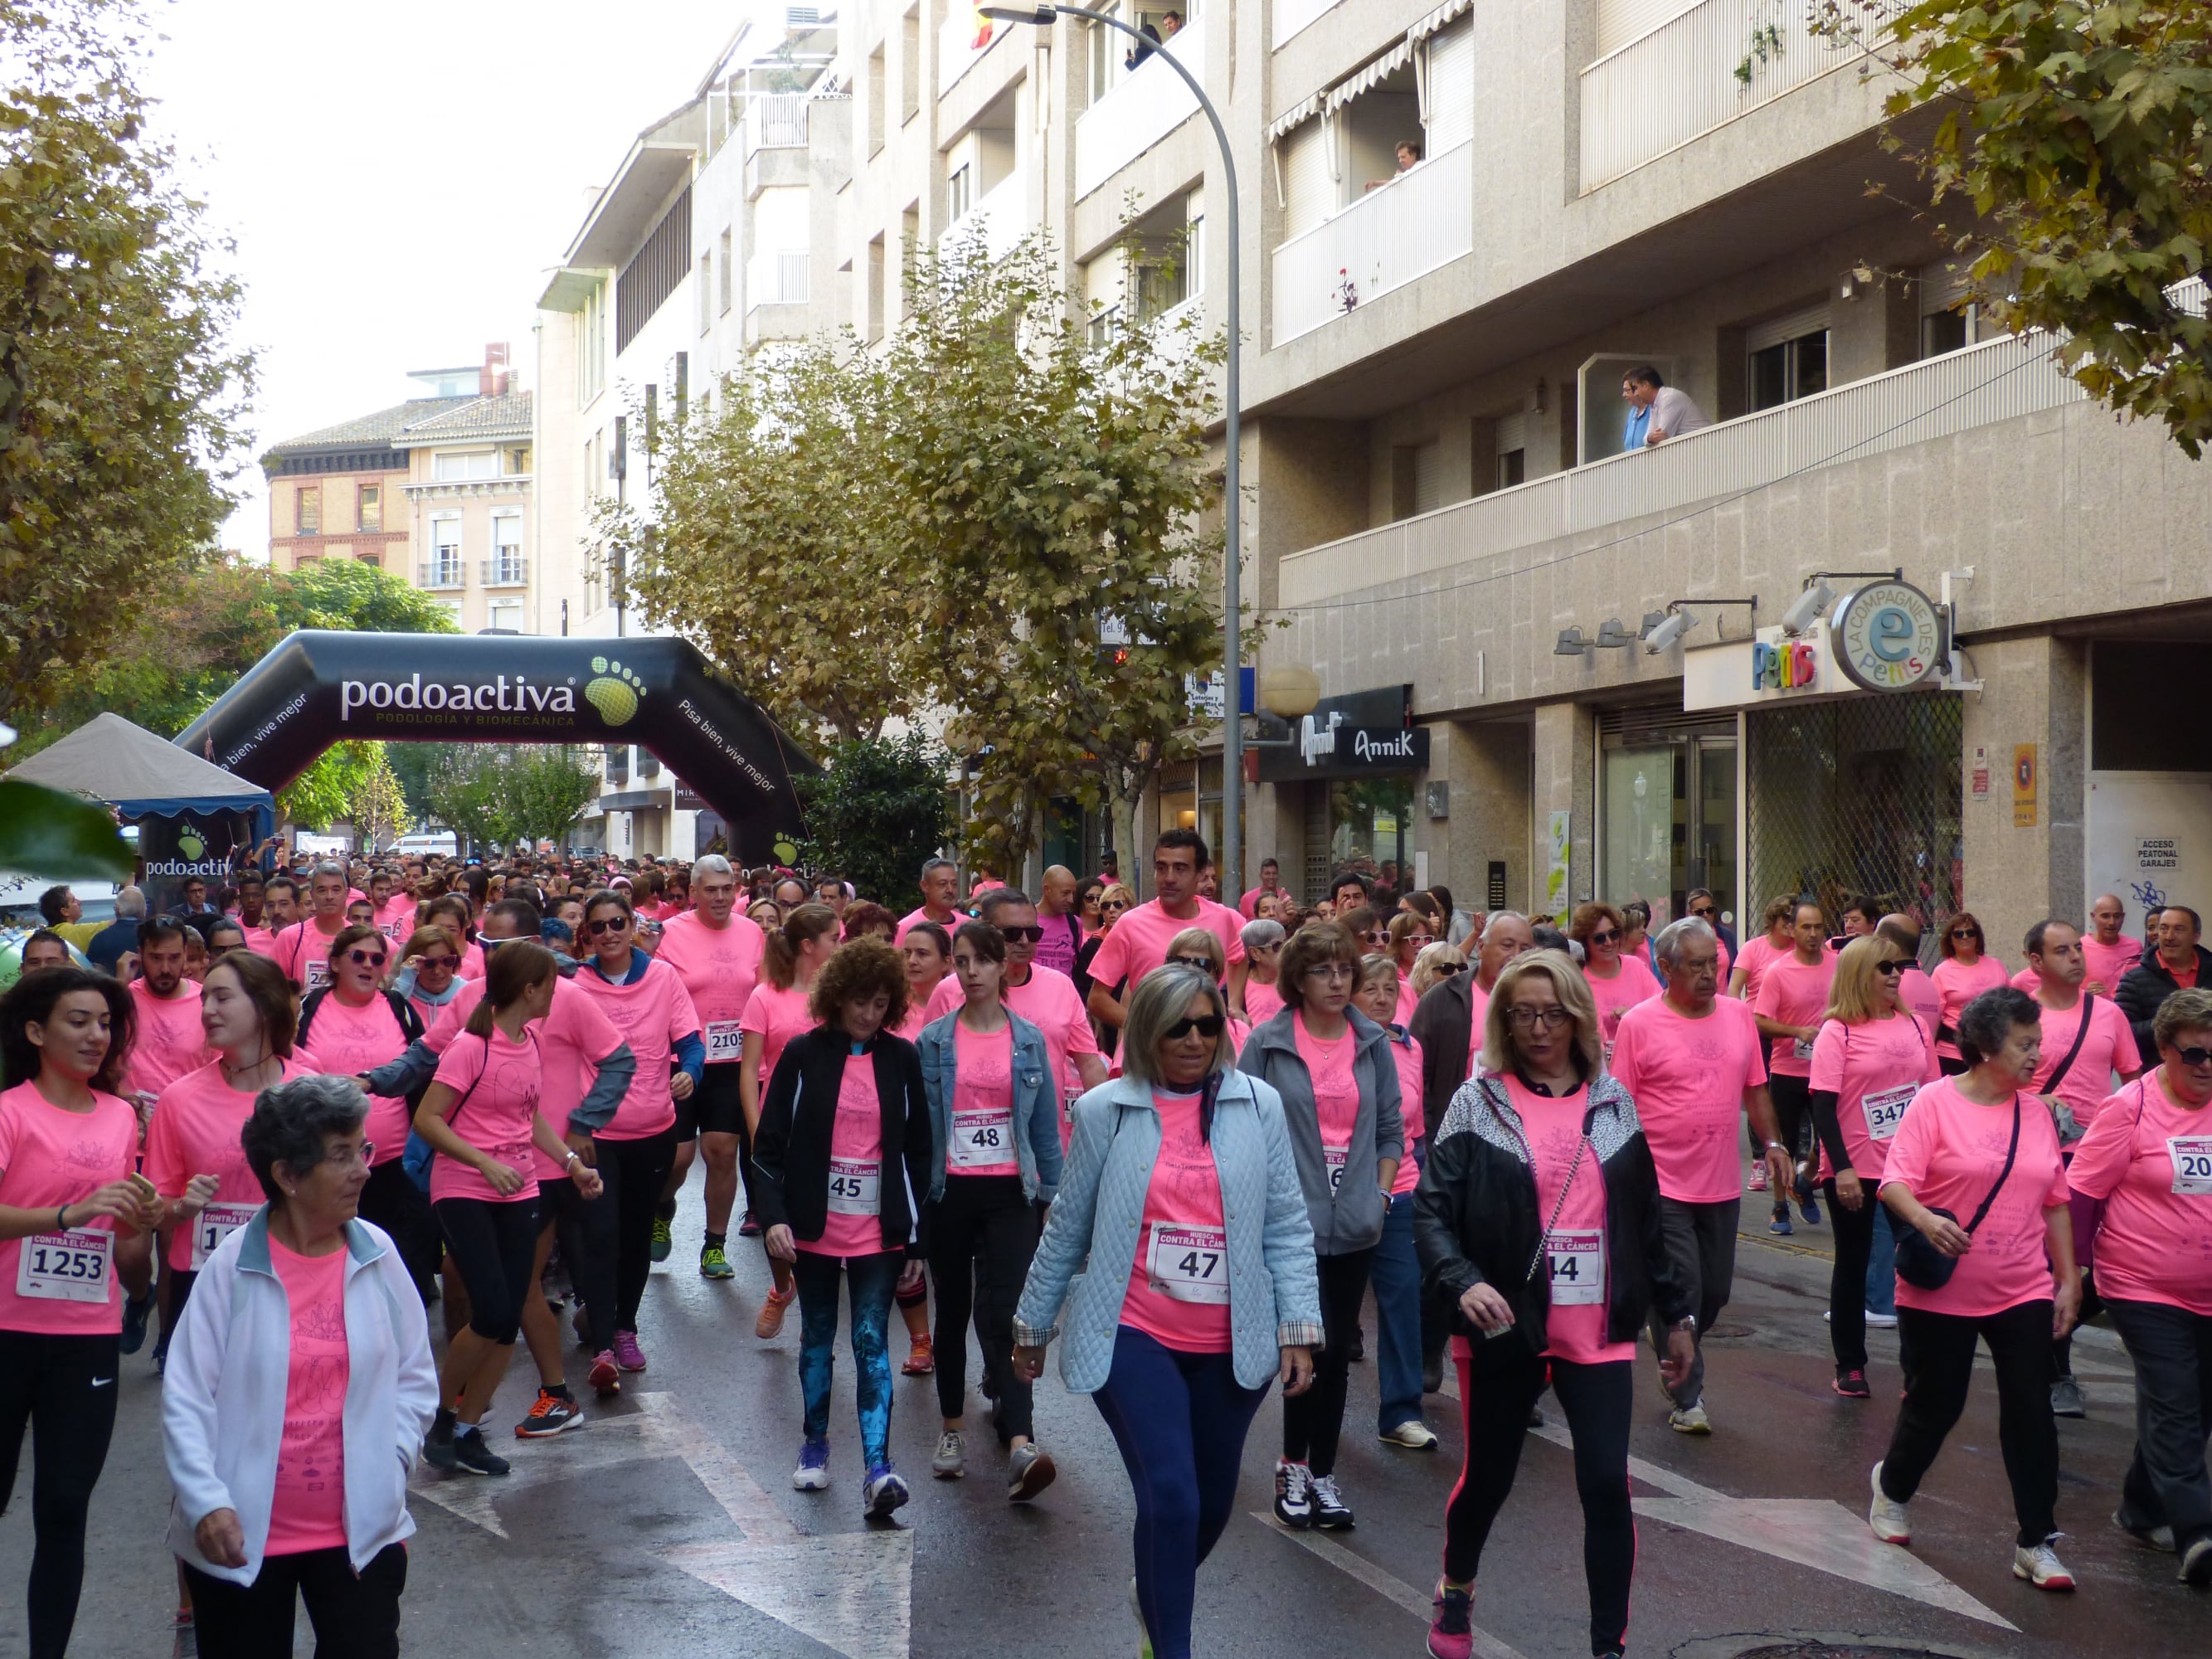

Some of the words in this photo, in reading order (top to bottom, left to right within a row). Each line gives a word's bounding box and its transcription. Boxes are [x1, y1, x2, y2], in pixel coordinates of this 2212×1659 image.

[1850, 590, 1928, 629] COMPAGNIE
[1102, 623, 1116, 633] Tel.
[1848, 631, 1864, 654] LA
[1917, 623, 1933, 657] DES
[1753, 640, 1815, 690] Petits
[1858, 653, 1923, 684] Petits
[341, 673, 576, 721] podoactiva
[376, 712, 457, 724] PODOLOGÍA
[463, 716, 470, 724] Y
[226, 742, 257, 766] bien,
[254, 715, 278, 742] vive
[275, 693, 307, 724] mejor
[678, 699, 702, 724] Pisa
[700, 720, 723, 749] bien,
[725, 745, 745, 765] vive
[744, 763, 775, 791] mejor
[2141, 859, 2176, 868] GARAJES
[971, 1128, 1000, 1147] 48
[853, 1166, 878, 1175] CÁNCER
[830, 1177, 862, 1197] 45
[205, 1214, 237, 1224] CONTRA
[34, 1235, 67, 1246] CONTRA
[69, 1239, 79, 1248] EL
[1160, 1234, 1194, 1246] CONTRA
[1197, 1238, 1207, 1247] EL
[1568, 1241, 1597, 1251] CÁNCER
[33, 1249, 103, 1279] 1253
[1179, 1252, 1219, 1278] 47
